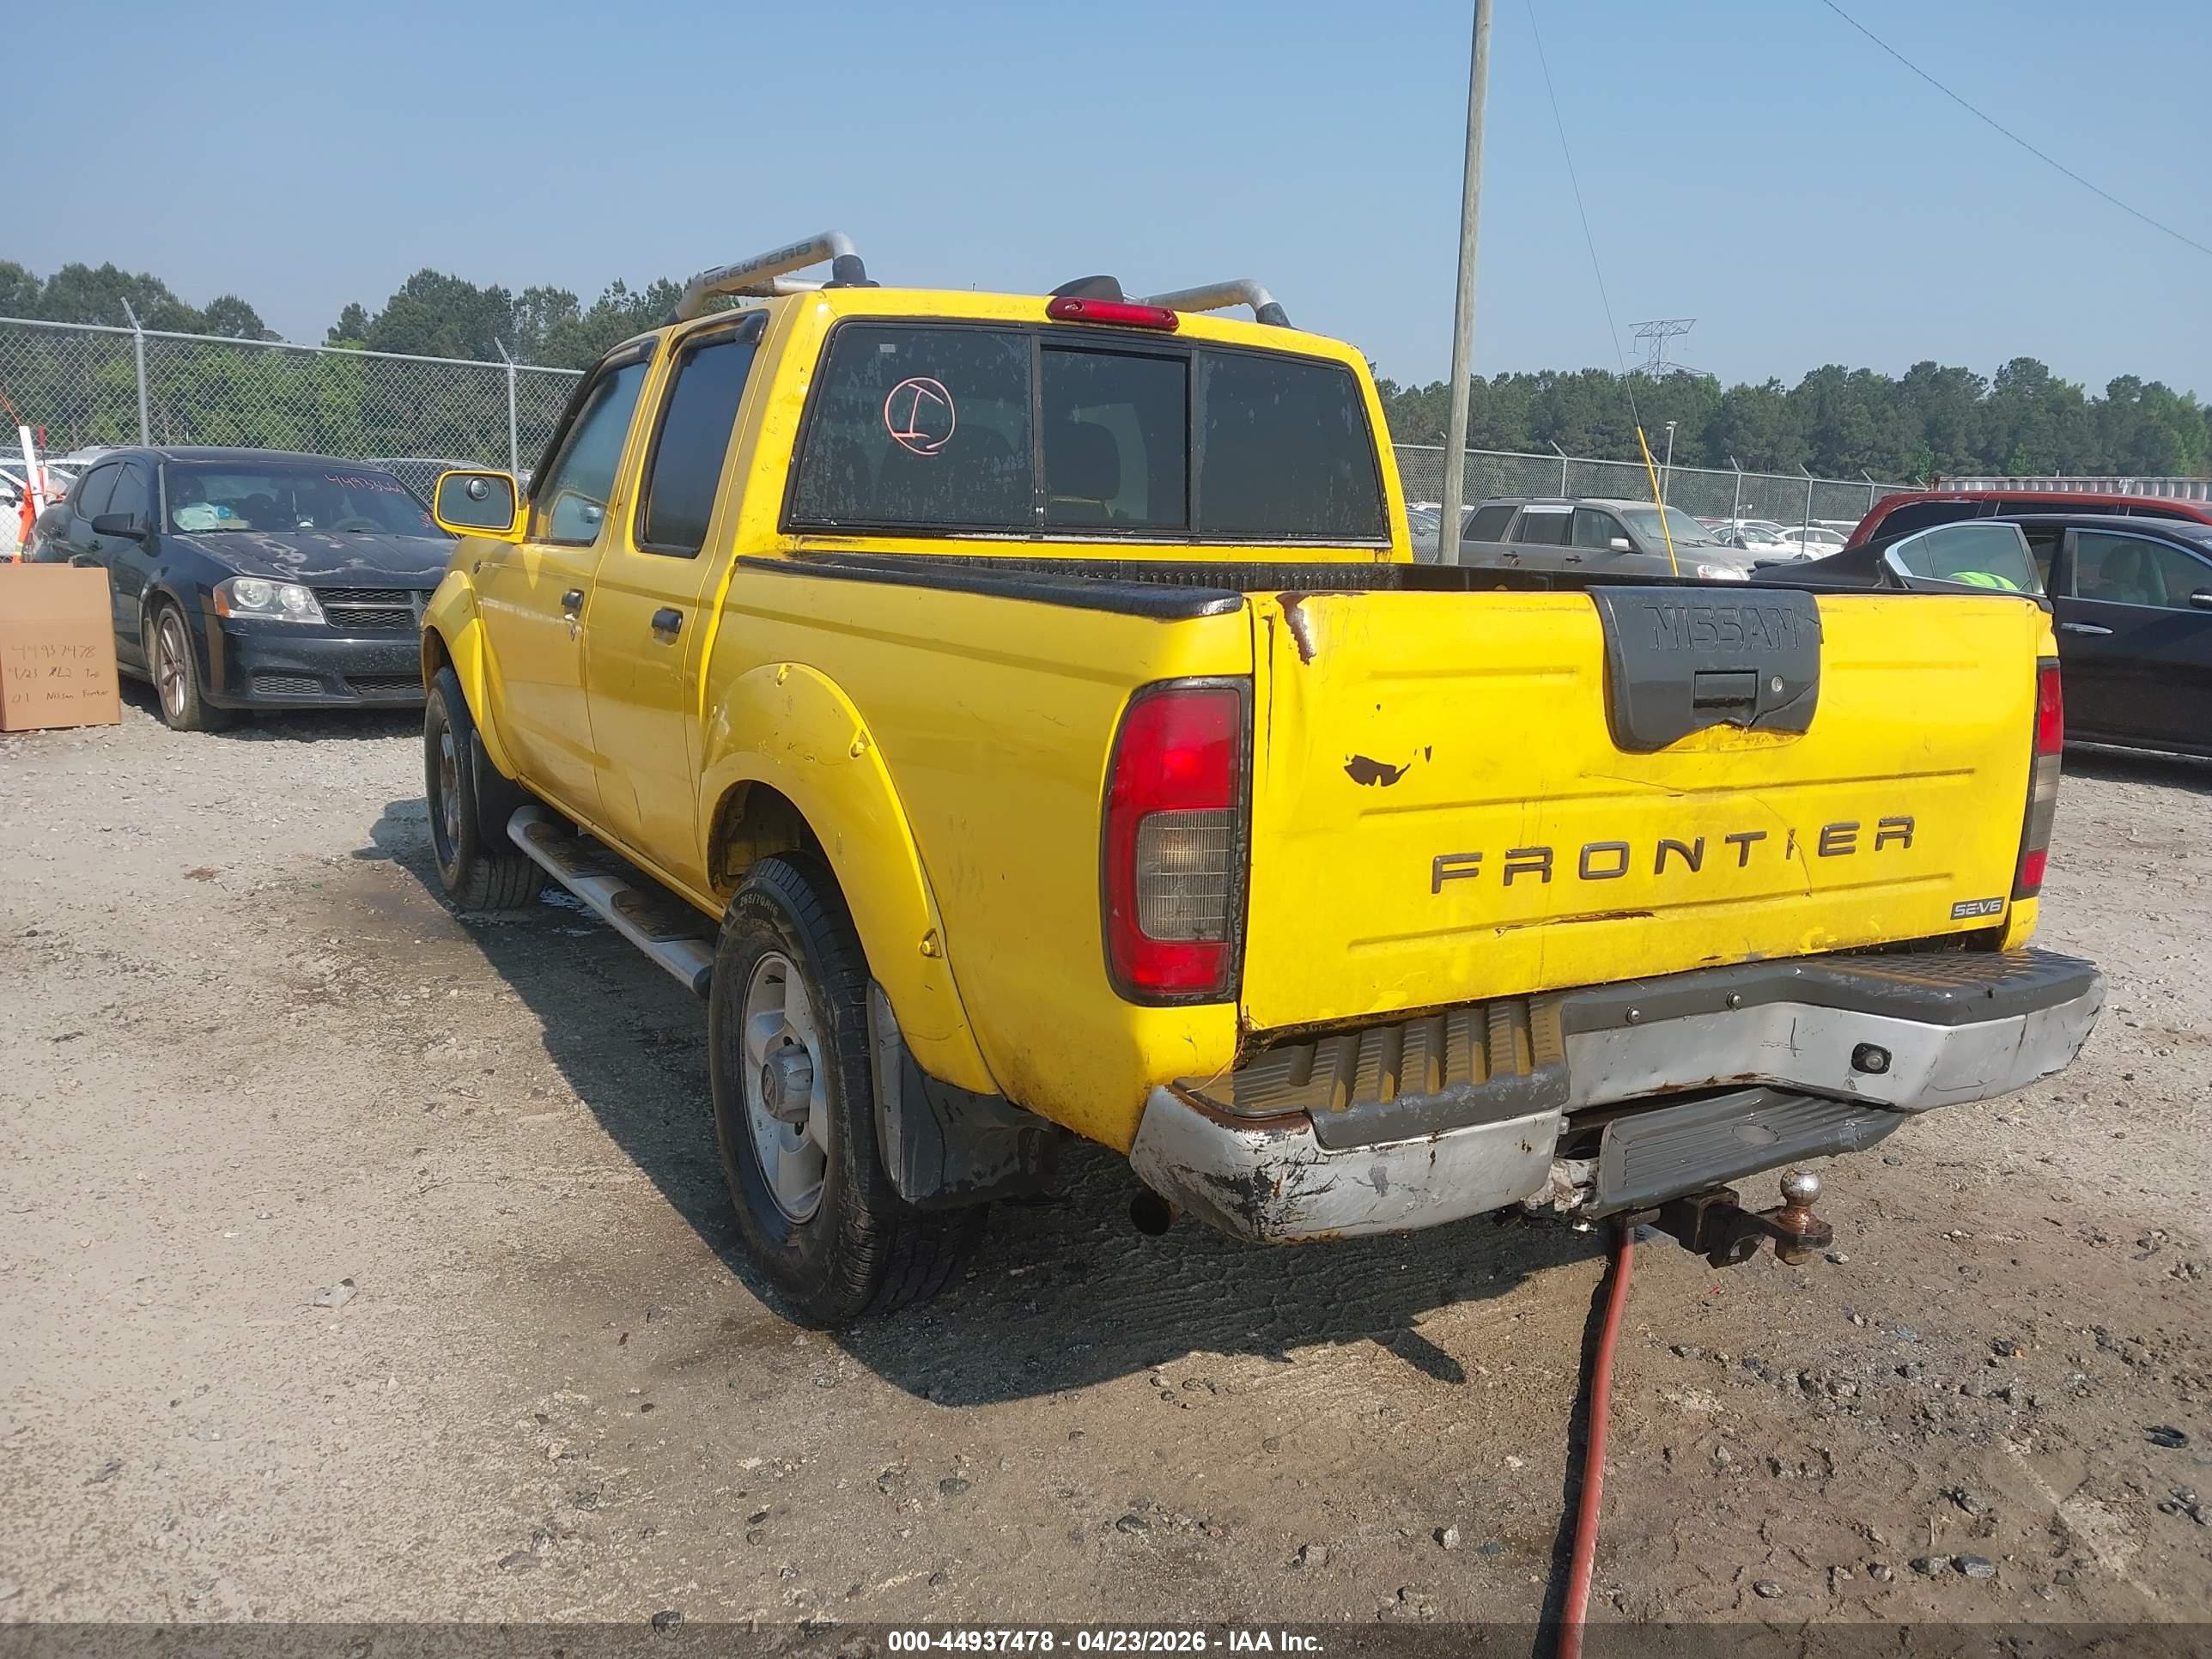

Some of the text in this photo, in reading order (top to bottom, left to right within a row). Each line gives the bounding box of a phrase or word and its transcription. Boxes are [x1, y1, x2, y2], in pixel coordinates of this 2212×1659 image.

[703, 241, 812, 287] CREW CAB
[1643, 605, 1800, 651] NISSAN
[1431, 815, 1917, 895] FRONTIER
